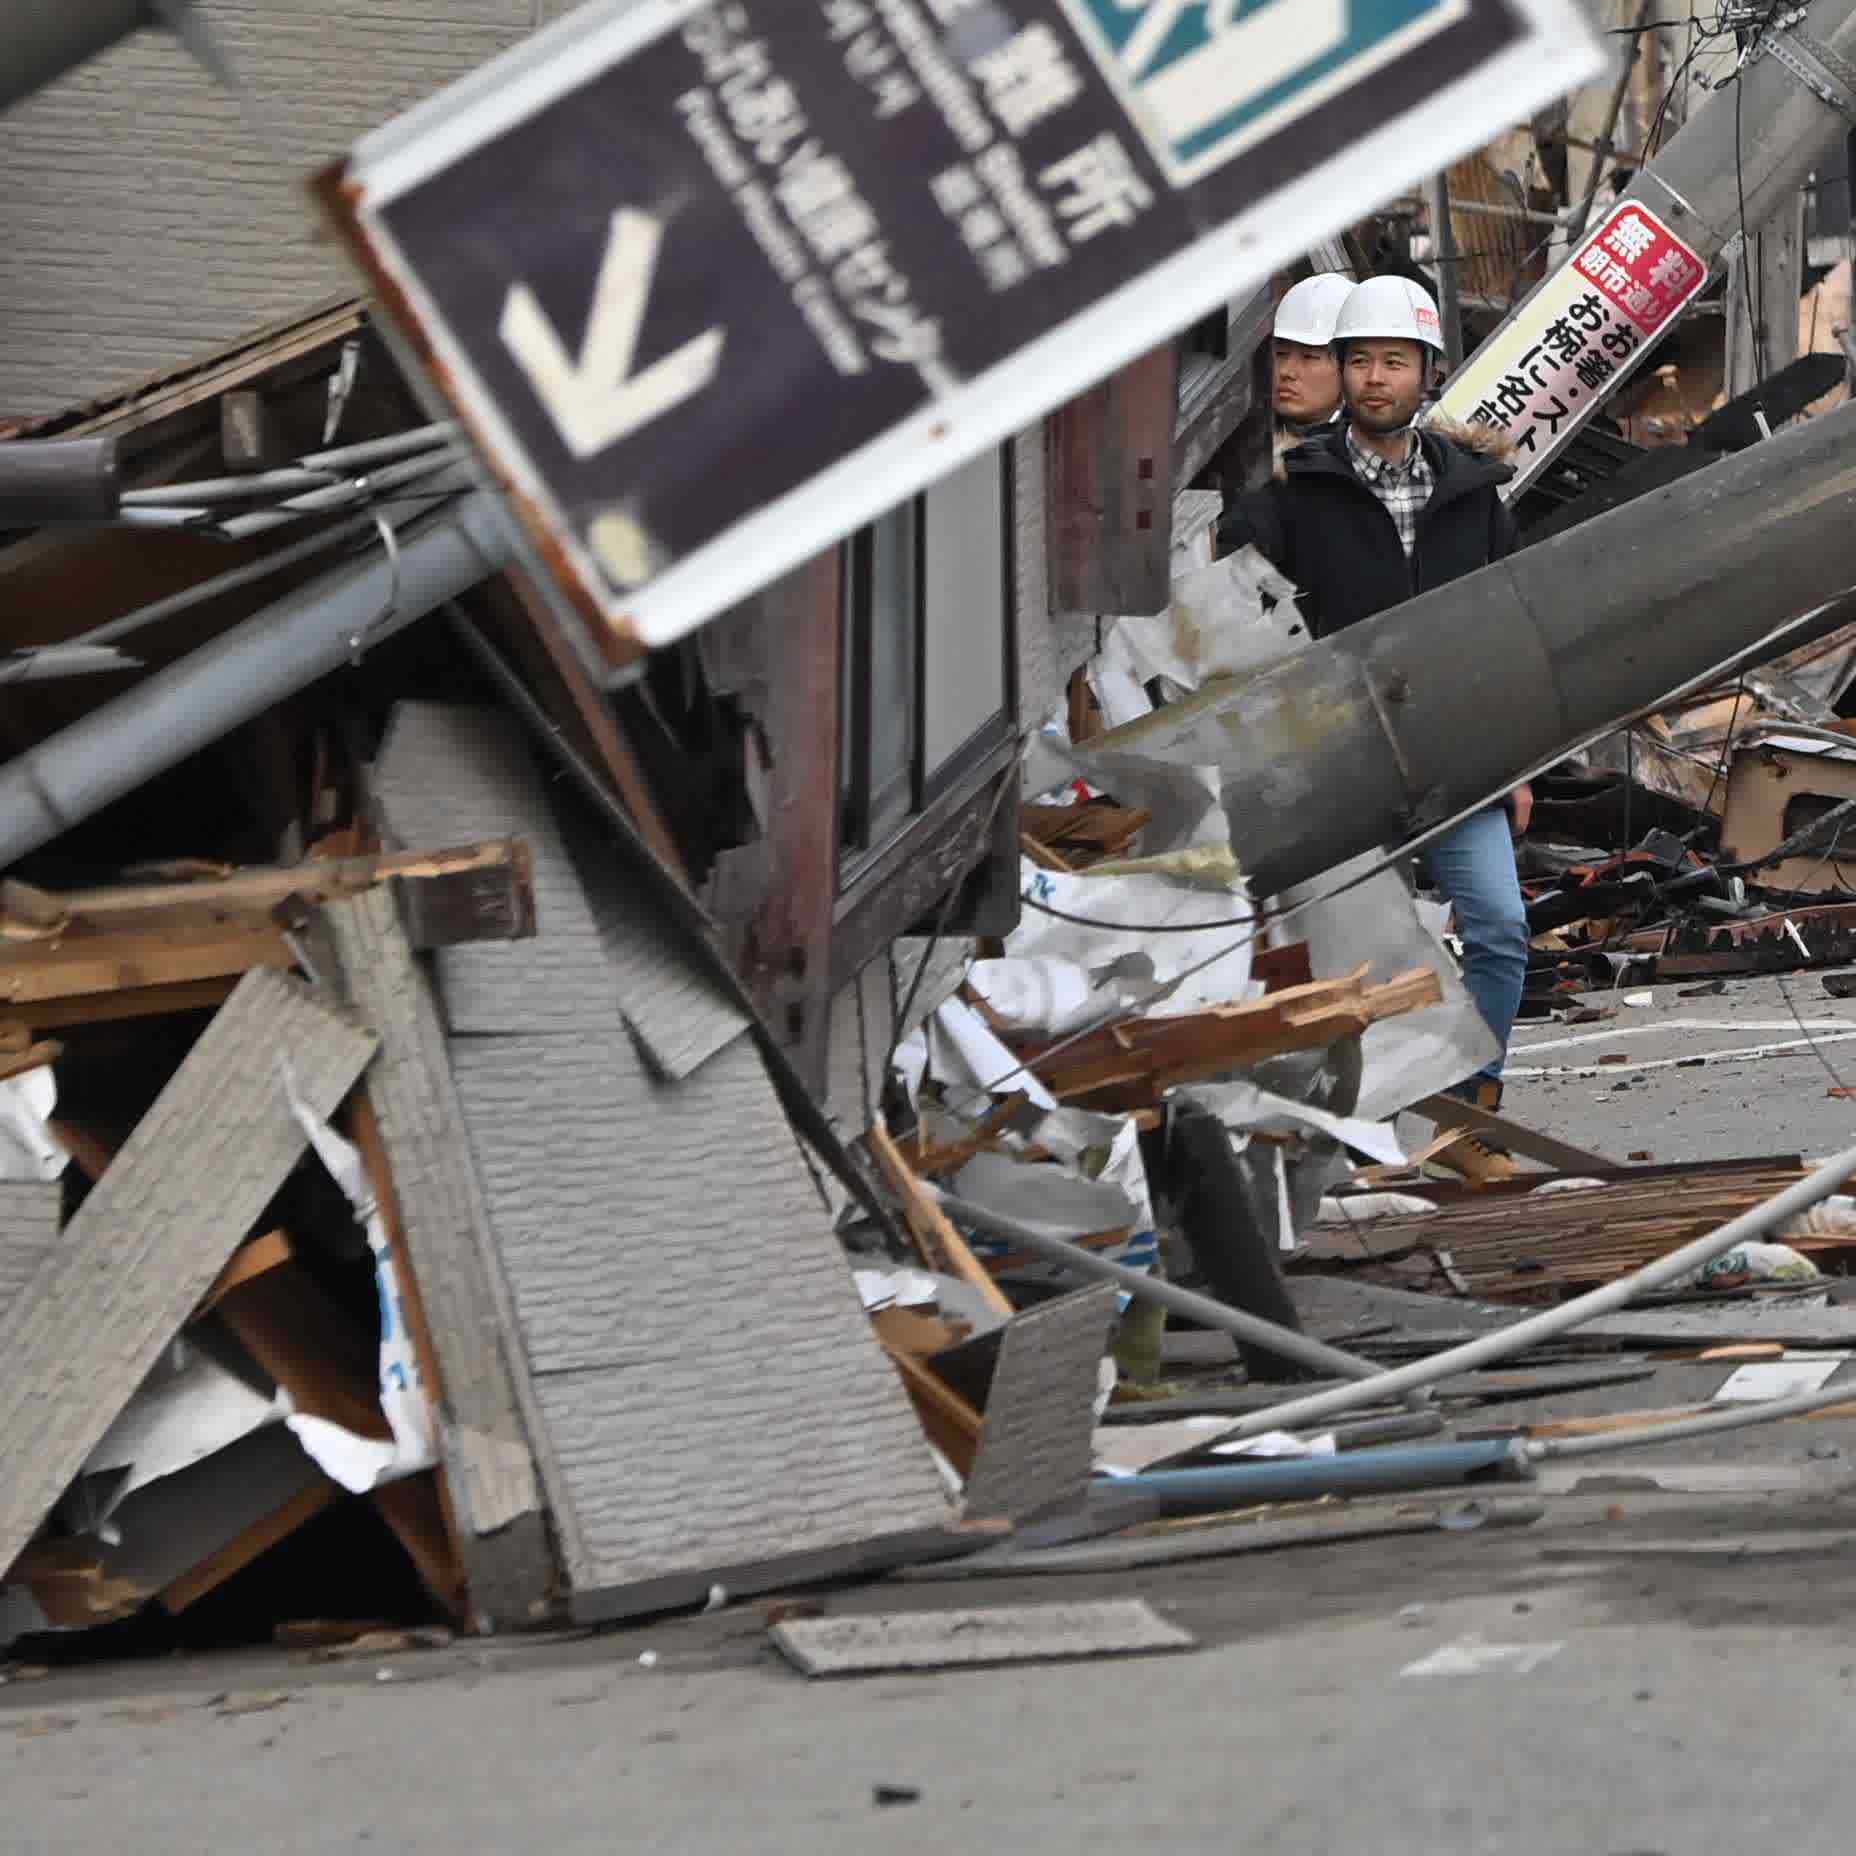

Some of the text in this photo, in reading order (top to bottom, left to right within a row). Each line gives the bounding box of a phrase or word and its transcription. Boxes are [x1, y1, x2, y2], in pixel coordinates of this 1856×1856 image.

[679, 0, 962, 403] ふれあい健康センター
[1579, 244, 1674, 324] 朝市通り
[1603, 213, 1697, 300] 無料
